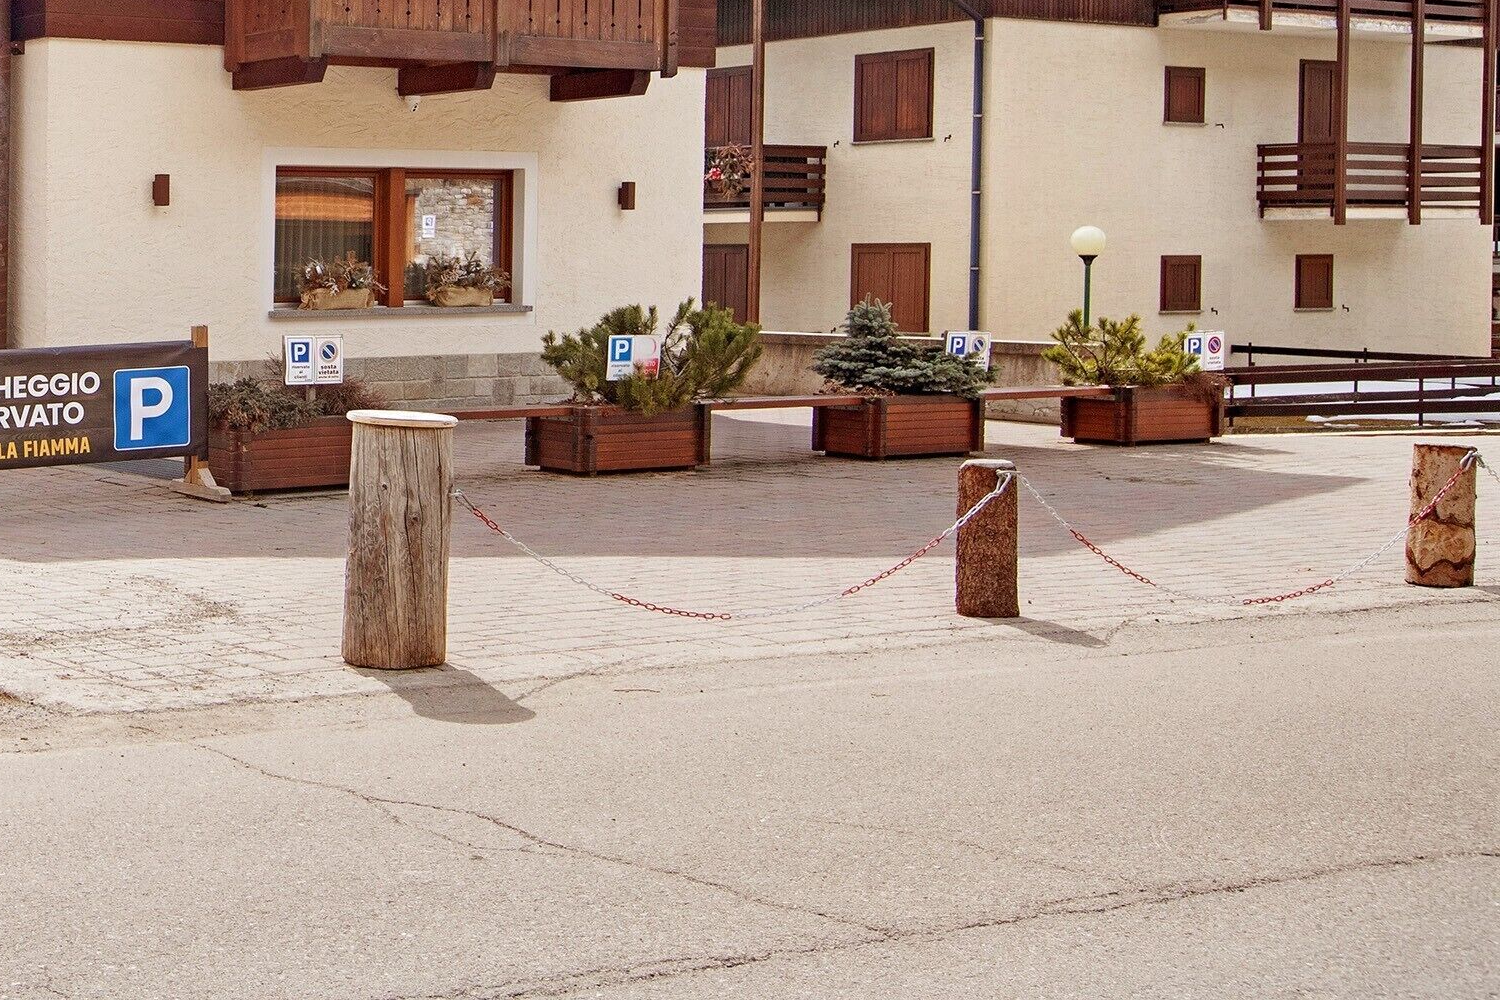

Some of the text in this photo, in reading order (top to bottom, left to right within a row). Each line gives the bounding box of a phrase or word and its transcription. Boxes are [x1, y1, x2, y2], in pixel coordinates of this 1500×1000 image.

[294, 344, 307, 361] P
[615, 340, 630, 360] P
[953, 338, 964, 354] P
[1190, 339, 1200, 354] P
[130, 376, 174, 441] P
[23, 436, 91, 458] FIAMMA
